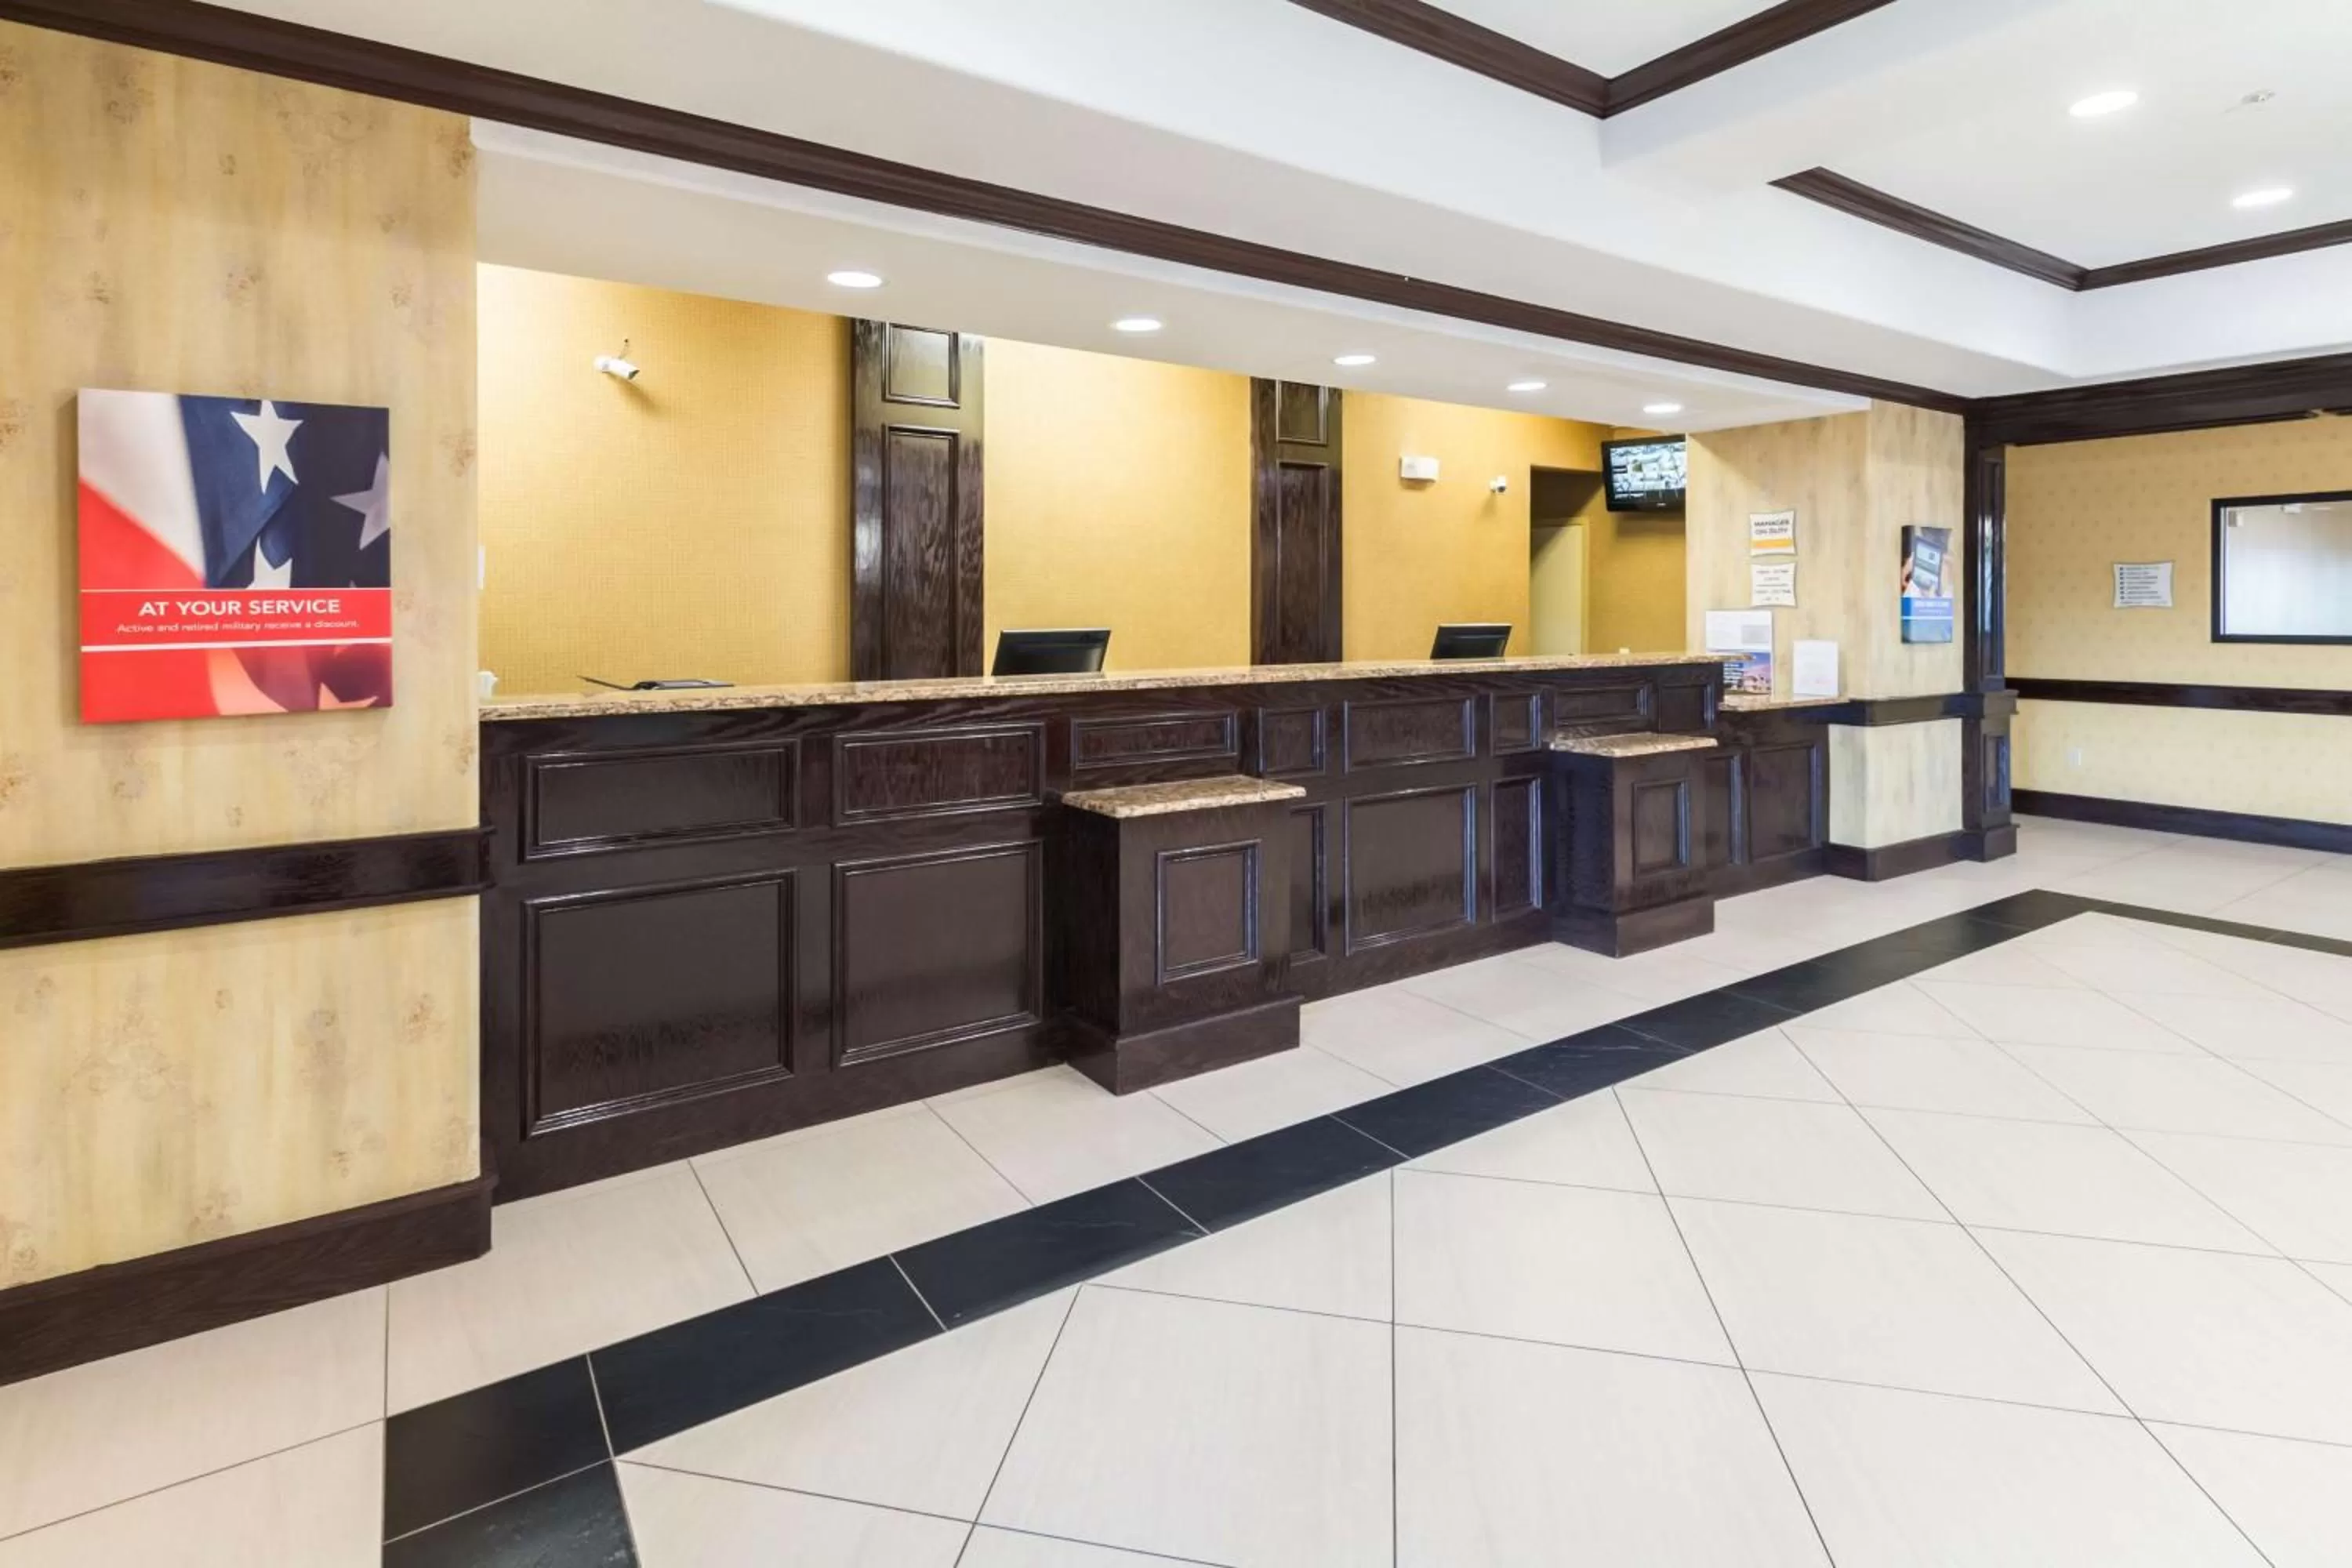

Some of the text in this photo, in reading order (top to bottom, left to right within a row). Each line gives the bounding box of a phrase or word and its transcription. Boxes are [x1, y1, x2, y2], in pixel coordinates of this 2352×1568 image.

[138, 599, 340, 616] AT YOUR SERVICE
[118, 623, 154, 633] Active
[158, 622, 180, 632] and
[181, 622, 219, 631] retired
[223, 621, 261, 632] military
[265, 621, 302, 630] receive
[314, 619, 359, 628] discount.
